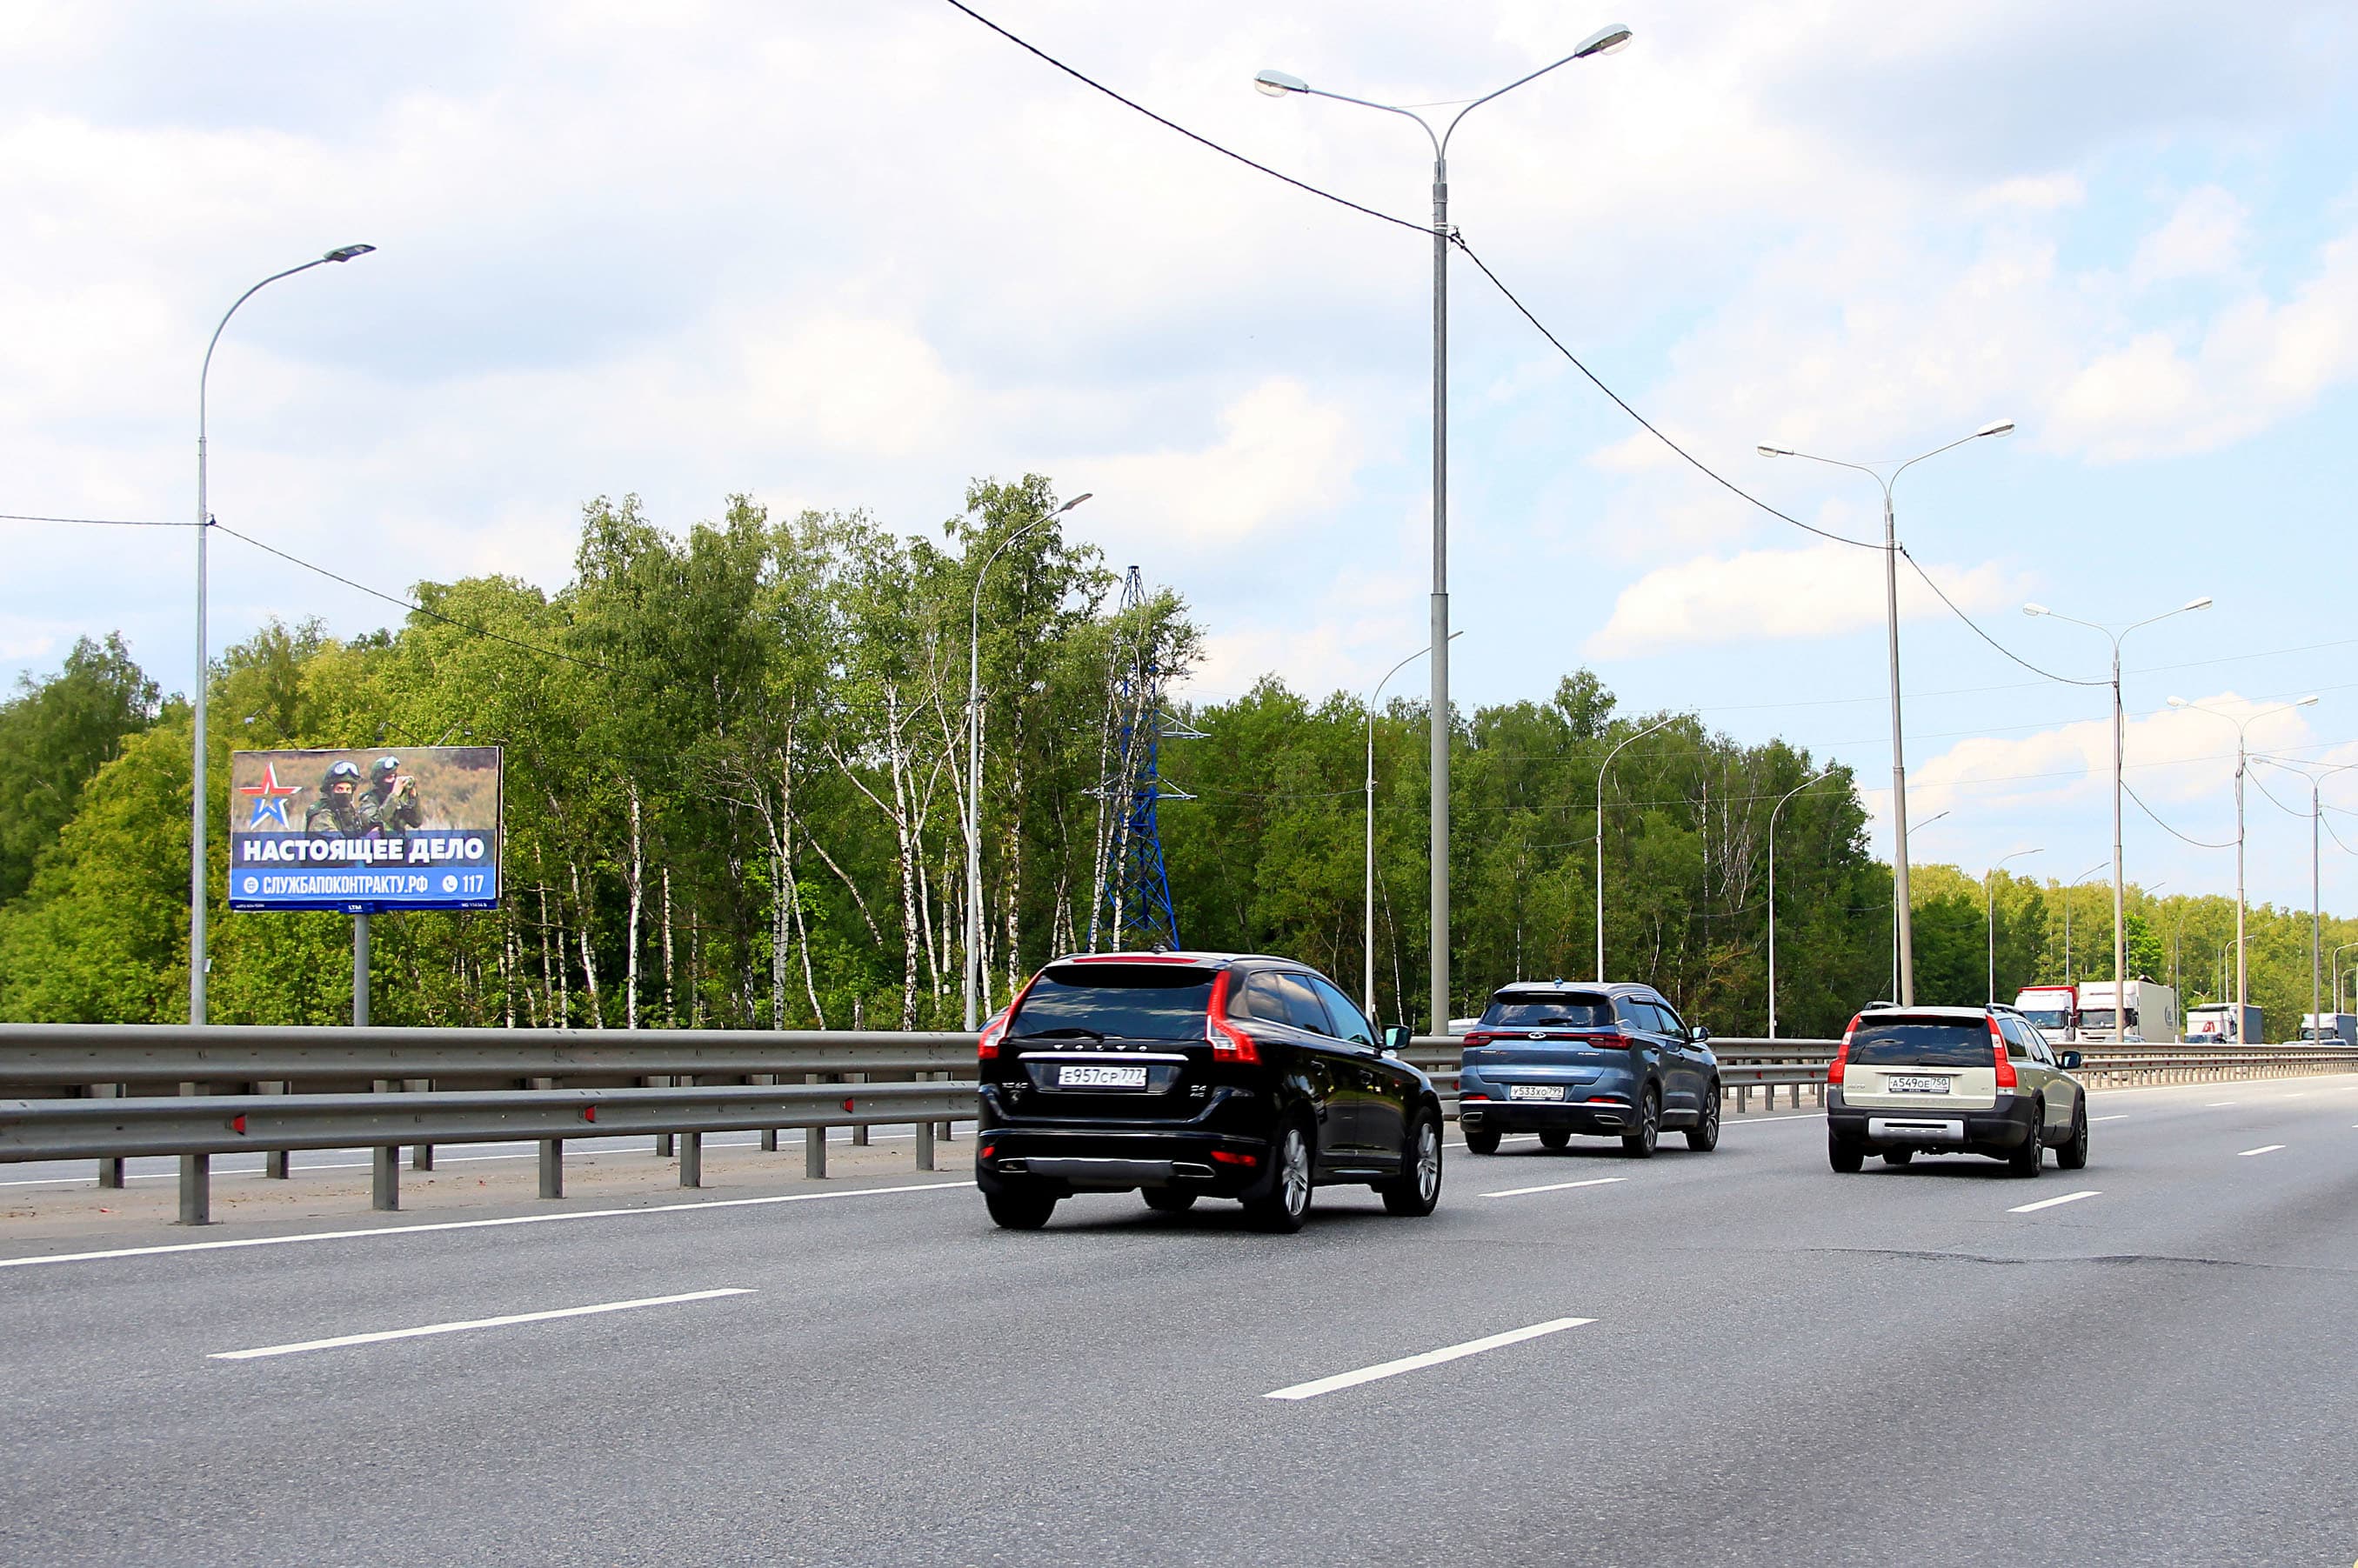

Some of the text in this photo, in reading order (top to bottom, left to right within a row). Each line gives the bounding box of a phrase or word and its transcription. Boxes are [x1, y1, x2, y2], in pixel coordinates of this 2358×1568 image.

[244, 837, 484, 864] НАСТОЯЩЕЕ ДЕЛО
[263, 875, 428, 894] СЛУЖБАПОКОНТРАКТУ.РФ
[462, 875, 484, 893] 117
